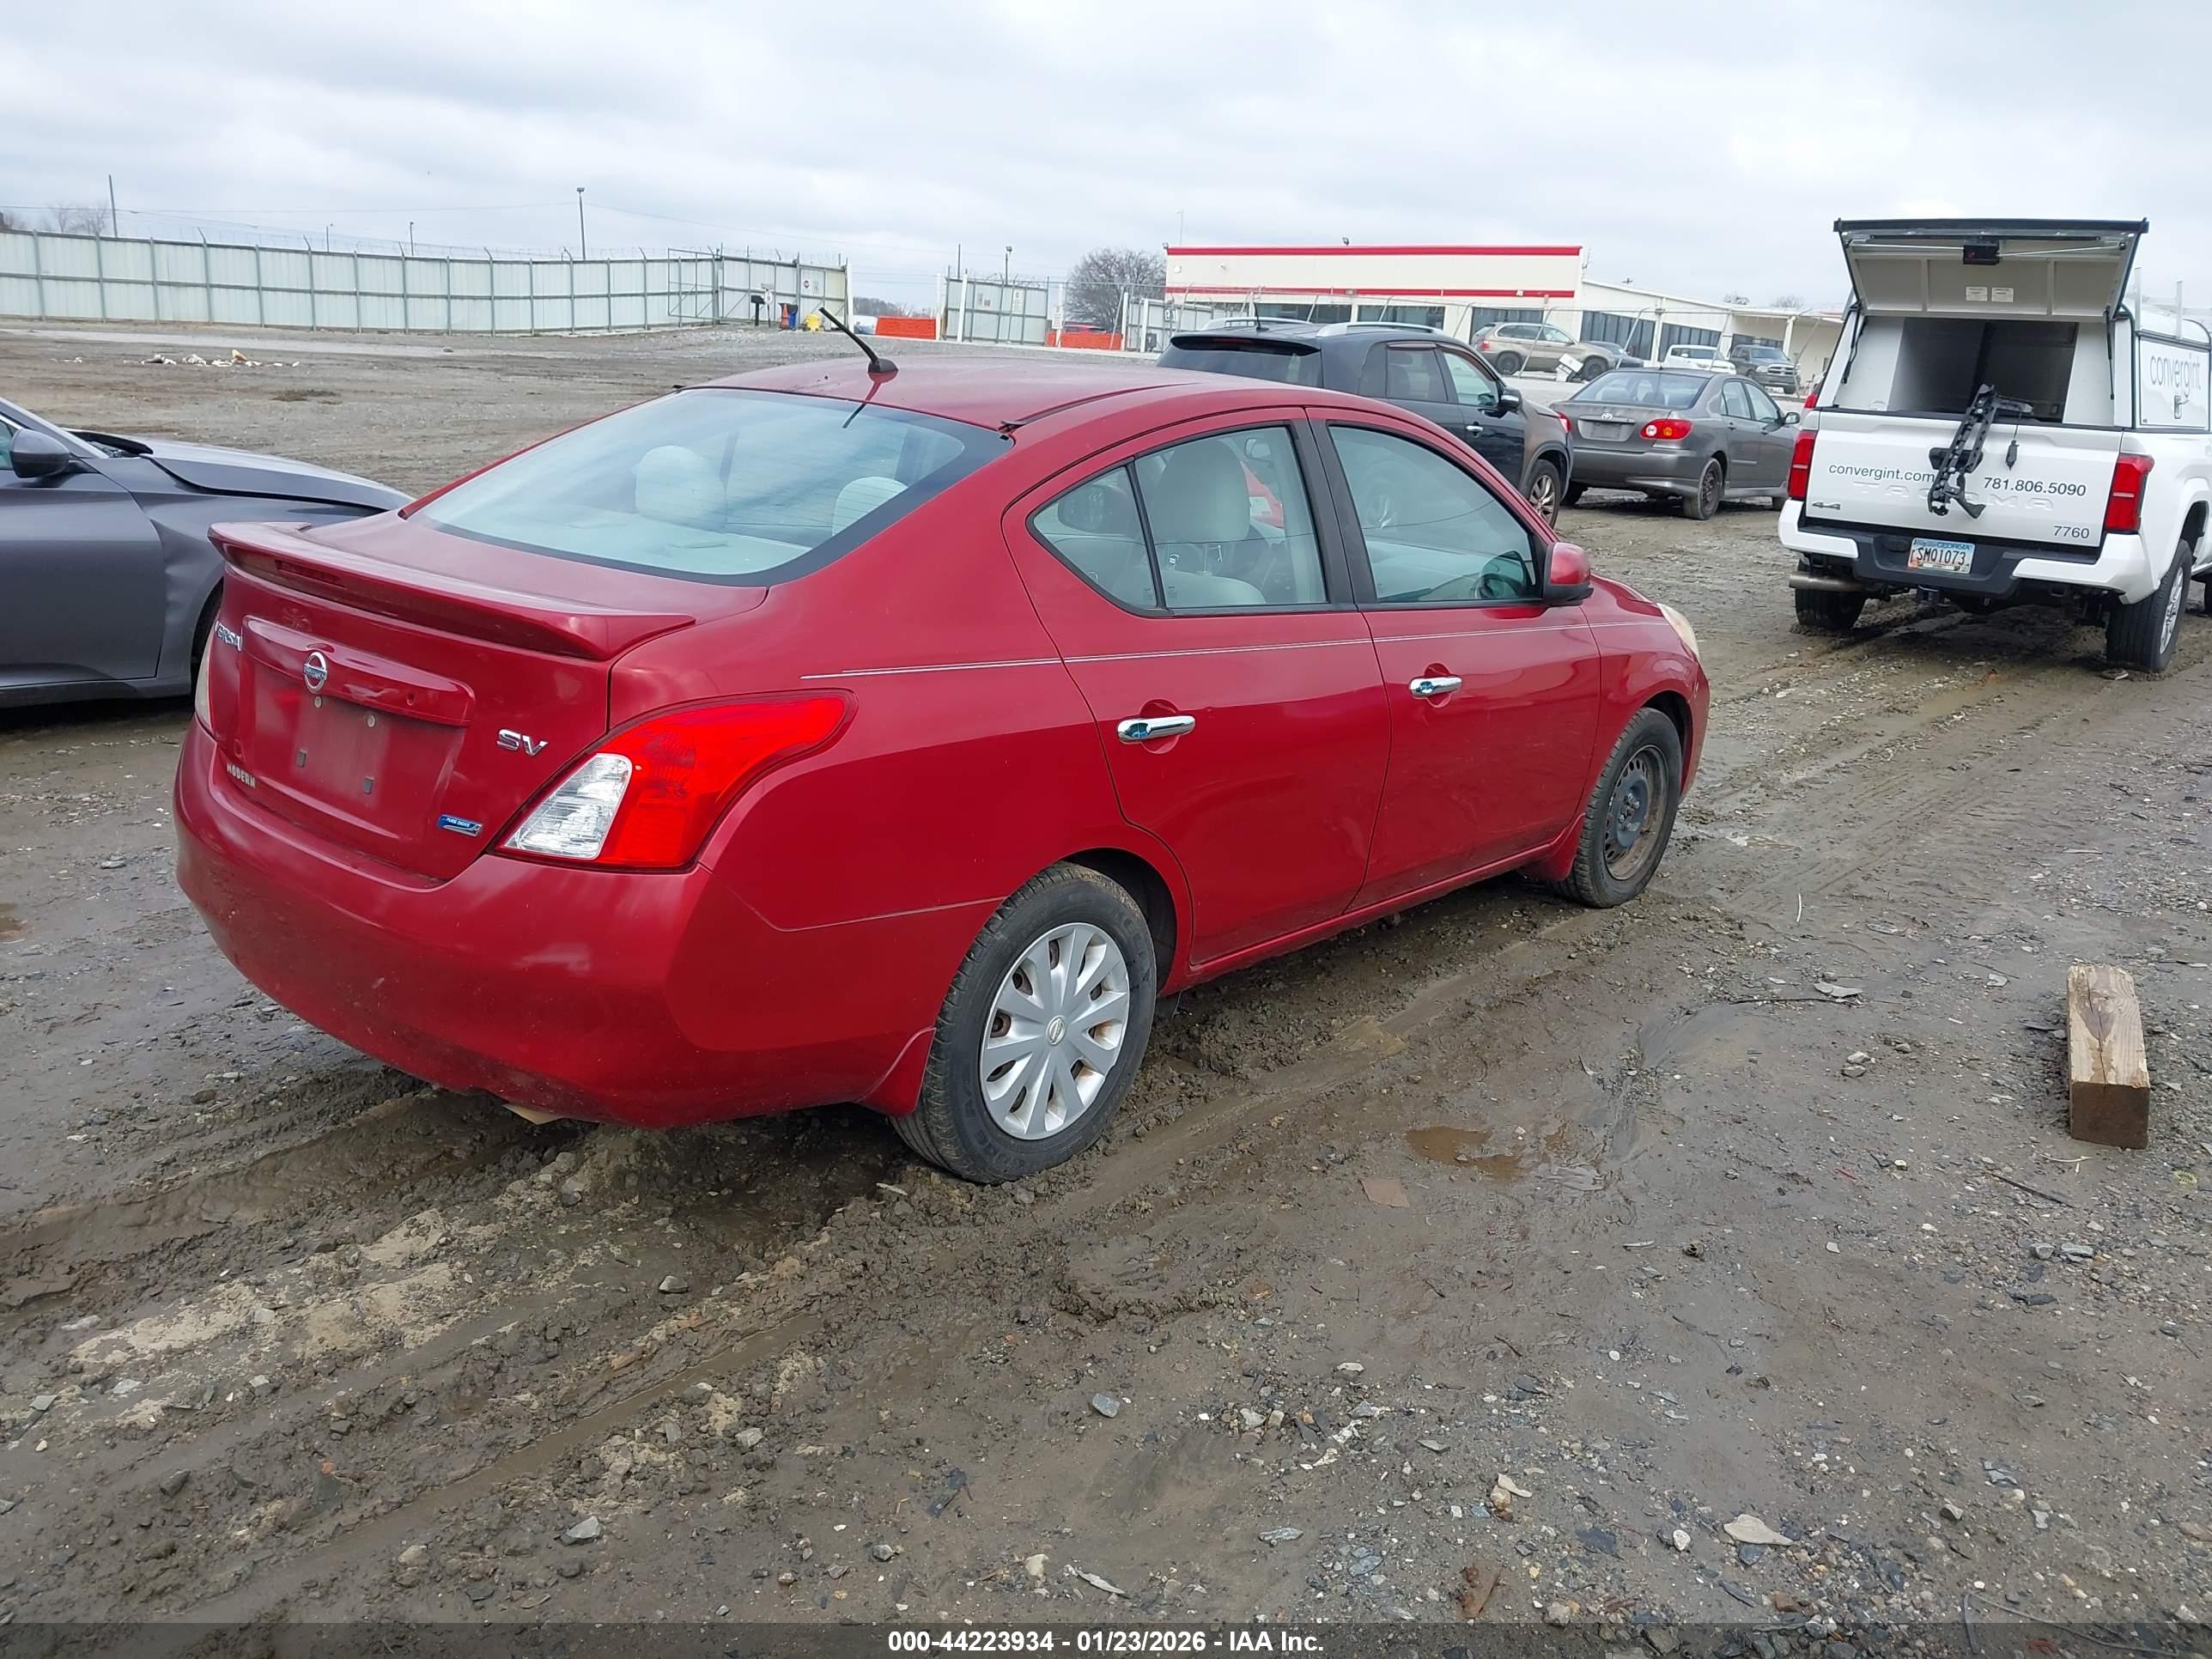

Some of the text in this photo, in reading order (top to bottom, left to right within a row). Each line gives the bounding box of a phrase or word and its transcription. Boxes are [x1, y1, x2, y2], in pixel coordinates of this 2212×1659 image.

[2150, 352, 2201, 398] convergint
[1829, 464, 1935, 483] convergint.com
[1984, 477, 2087, 496] 781.806.5090
[2053, 526, 2090, 539] 7760
[496, 729, 550, 756] SV
[227, 763, 256, 789] MODERN
